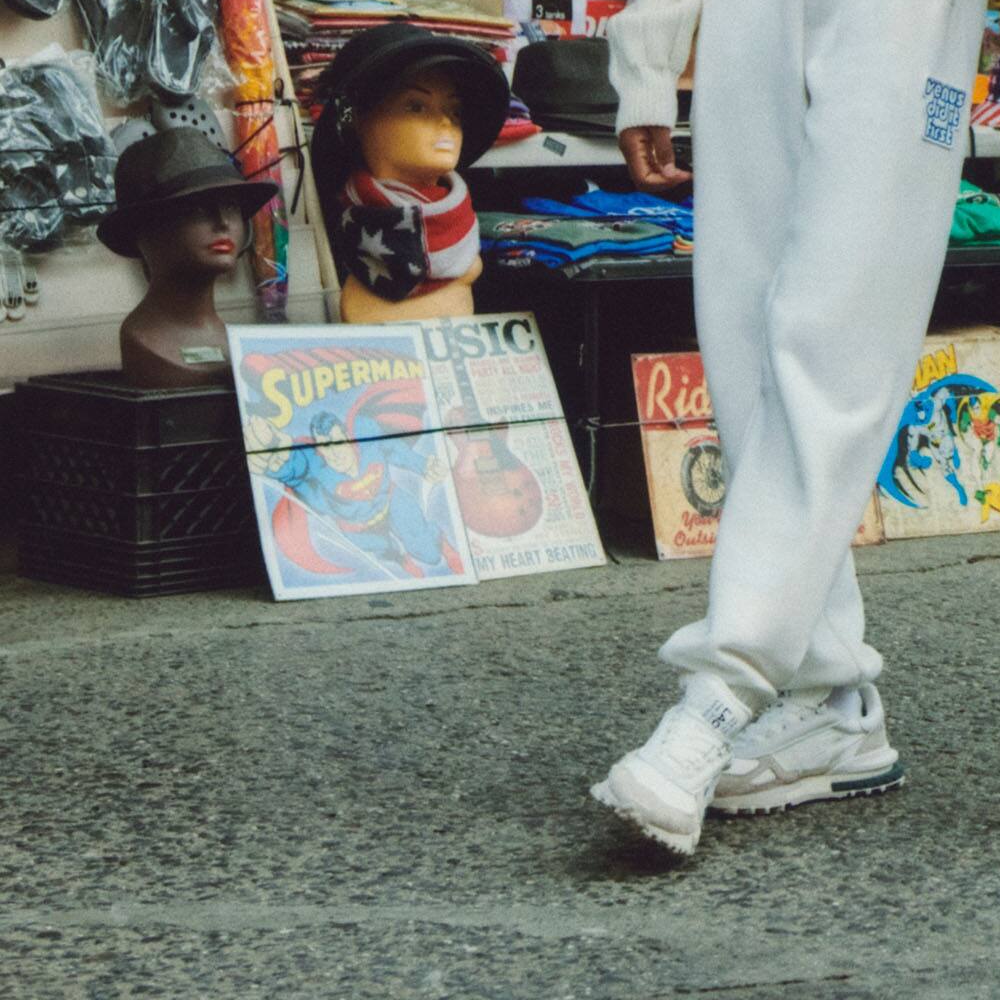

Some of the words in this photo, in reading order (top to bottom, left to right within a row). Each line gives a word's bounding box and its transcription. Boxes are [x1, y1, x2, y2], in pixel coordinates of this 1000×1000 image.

[536, 4, 544, 19] 3
[927, 101, 948, 121] did
[948, 104, 960, 127] it
[424, 318, 535, 362] USIC
[262, 359, 425, 429] SUPERMAN
[486, 403, 534, 416] INSPIRES
[537, 400, 554, 411] ME
[474, 555, 496, 571] MY
[500, 549, 542, 569] HEART
[545, 543, 597, 564] BEATING
